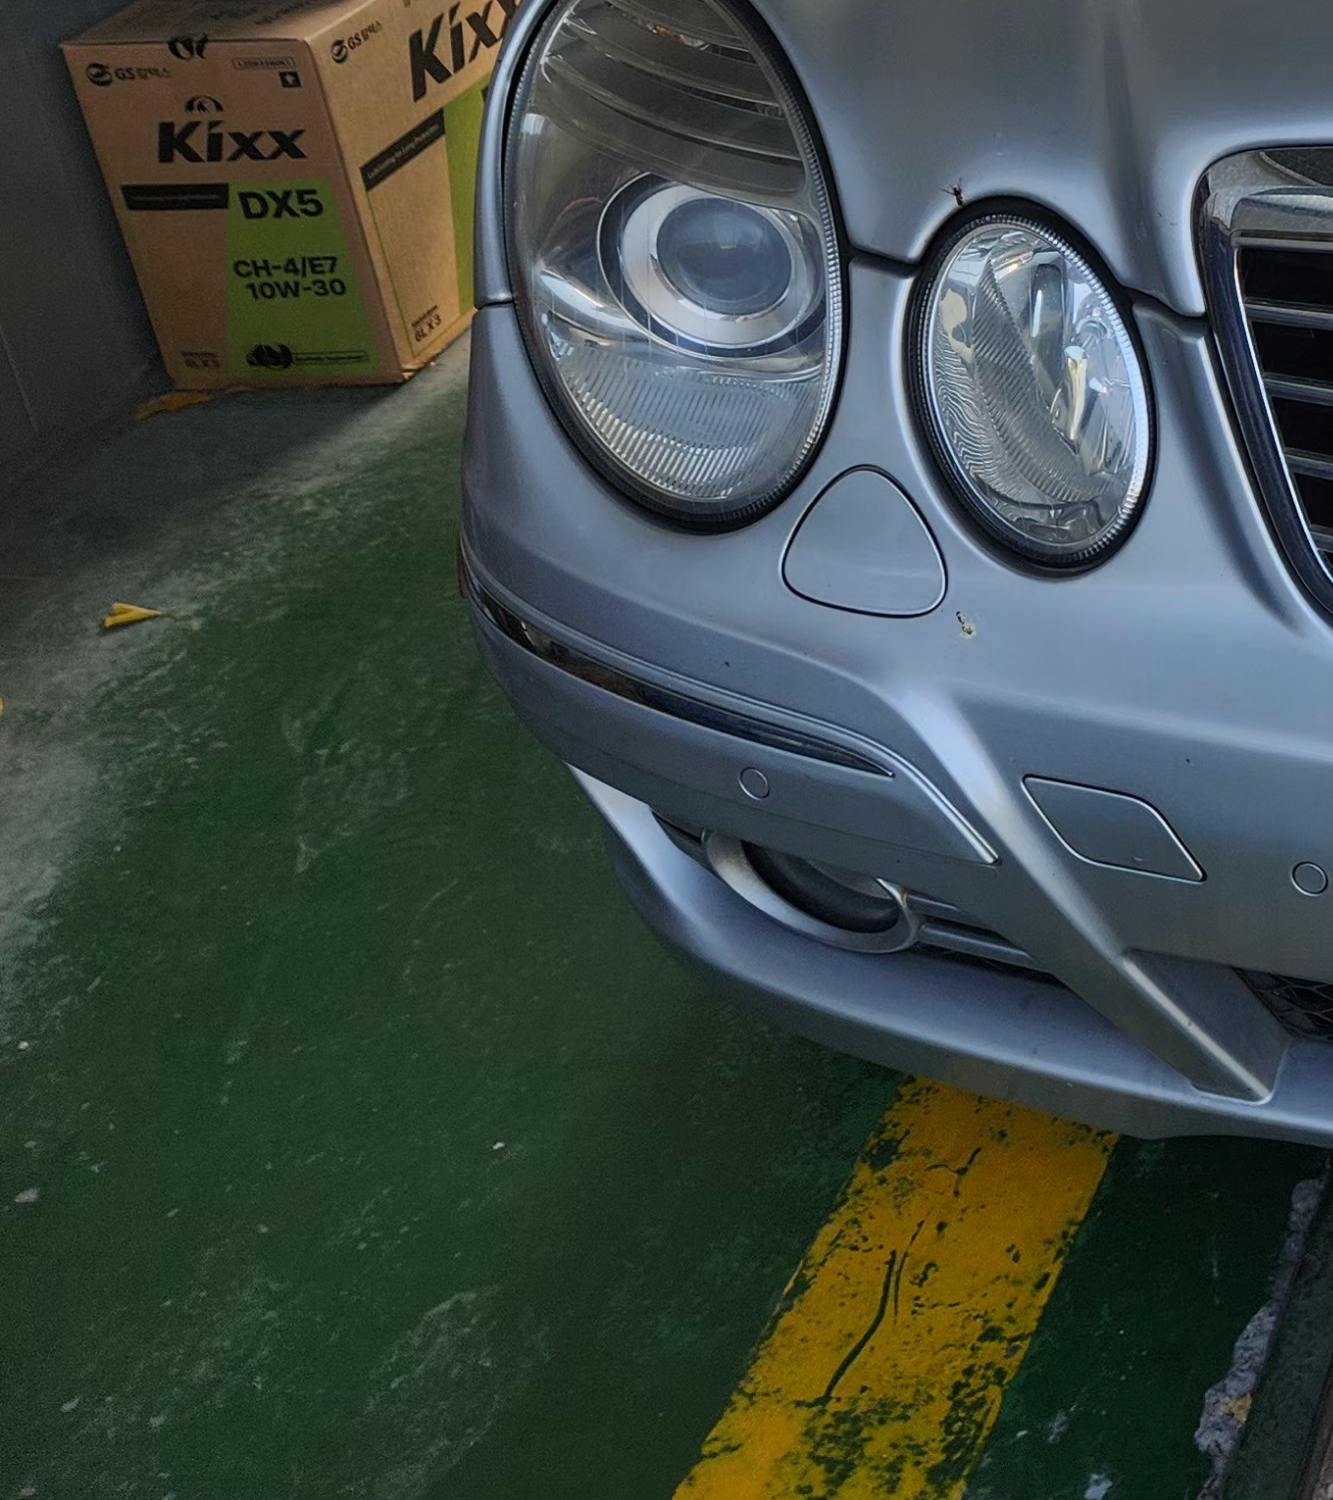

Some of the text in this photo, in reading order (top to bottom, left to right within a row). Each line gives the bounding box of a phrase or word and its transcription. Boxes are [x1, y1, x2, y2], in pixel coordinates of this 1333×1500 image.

[158, 119, 308, 164] Kixx
[237, 188, 324, 221] DX5
[233, 255, 339, 279] CH-4/E7
[246, 277, 347, 301] 10W-30
